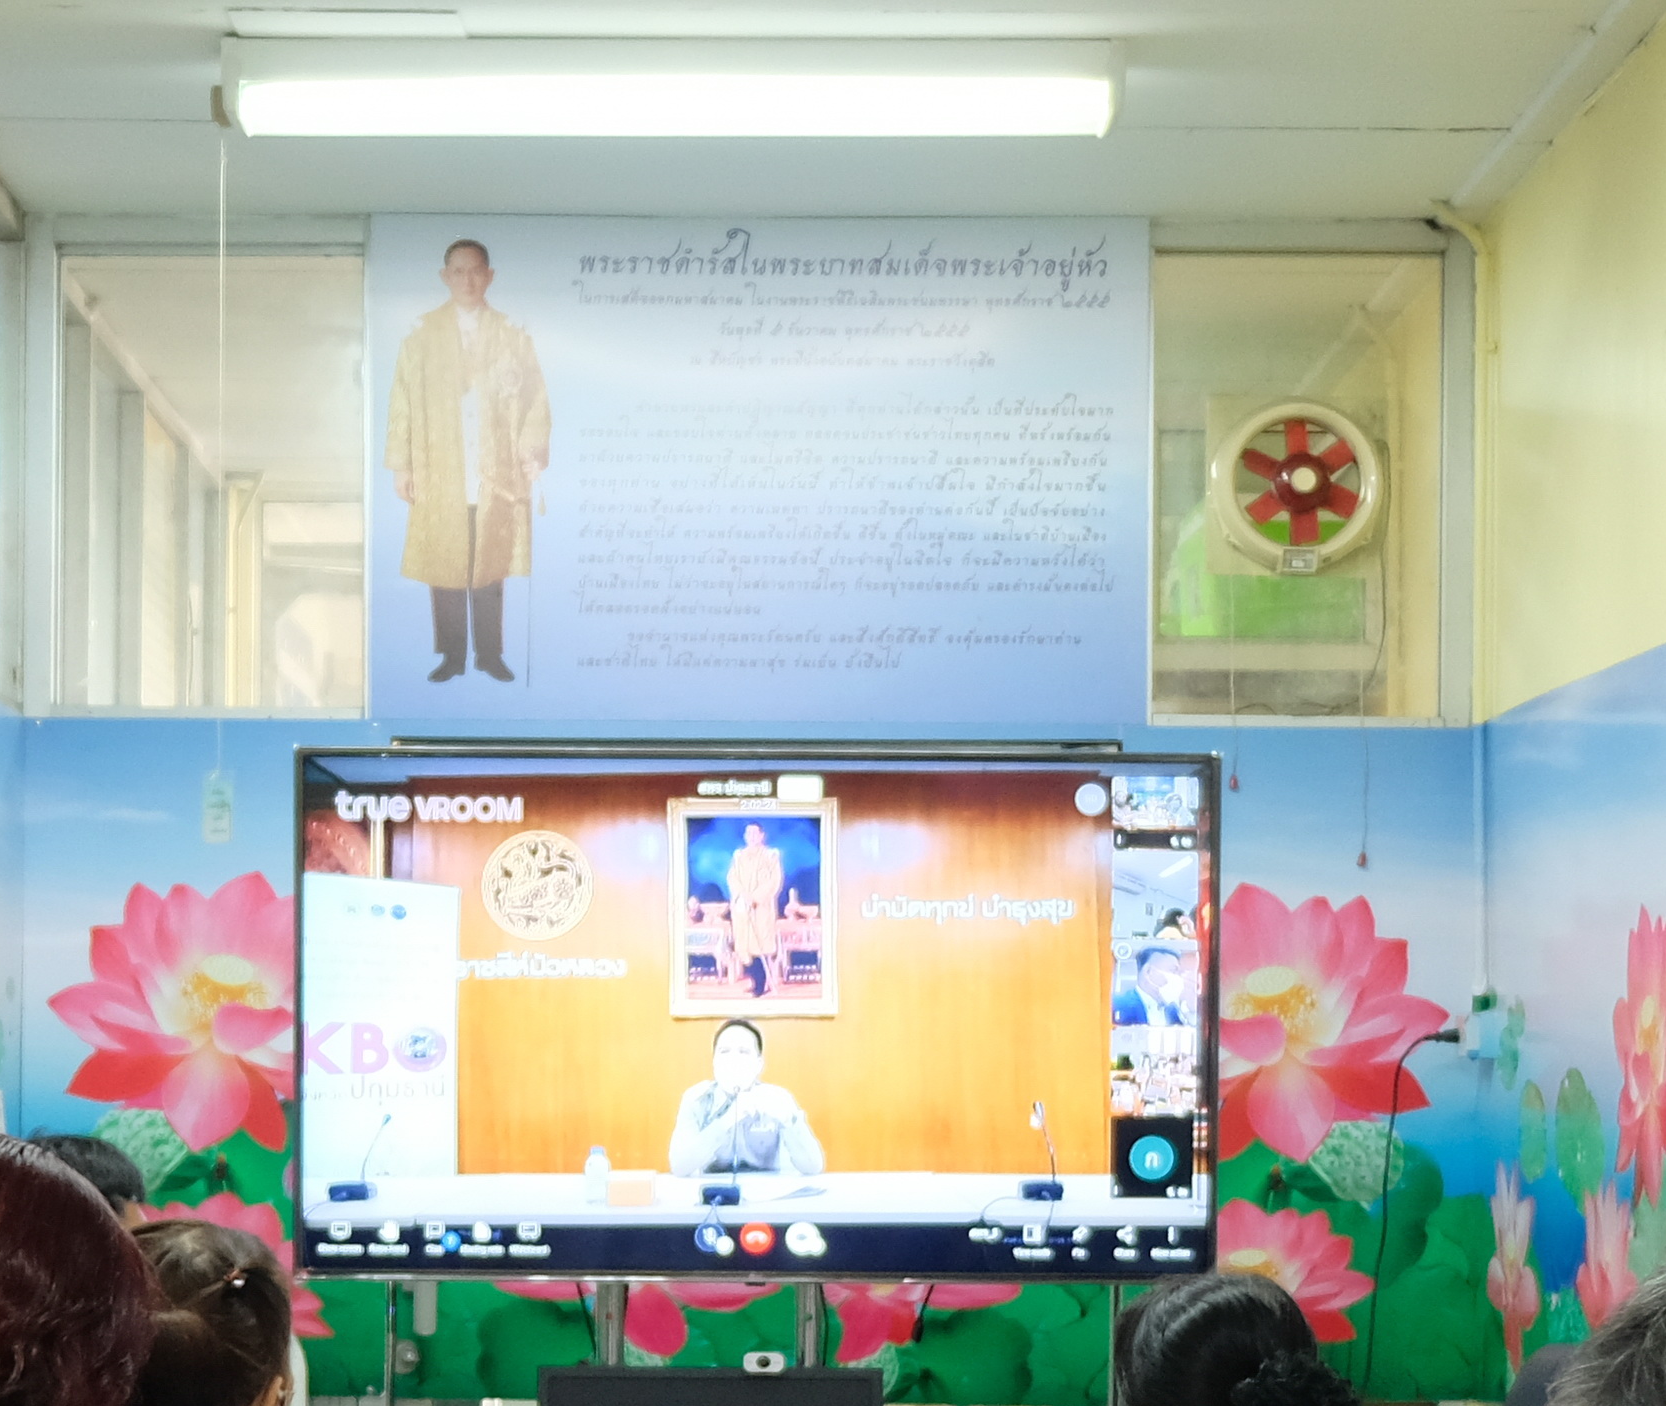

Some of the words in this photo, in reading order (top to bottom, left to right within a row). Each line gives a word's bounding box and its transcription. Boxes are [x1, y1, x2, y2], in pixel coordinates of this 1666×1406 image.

[578, 228, 1108, 292] พระราชดำรัสในพระบาทสมเด็จพระเจ้าอยู่หัว
[334, 790, 414, 823] true
[414, 795, 525, 823] VROOM
